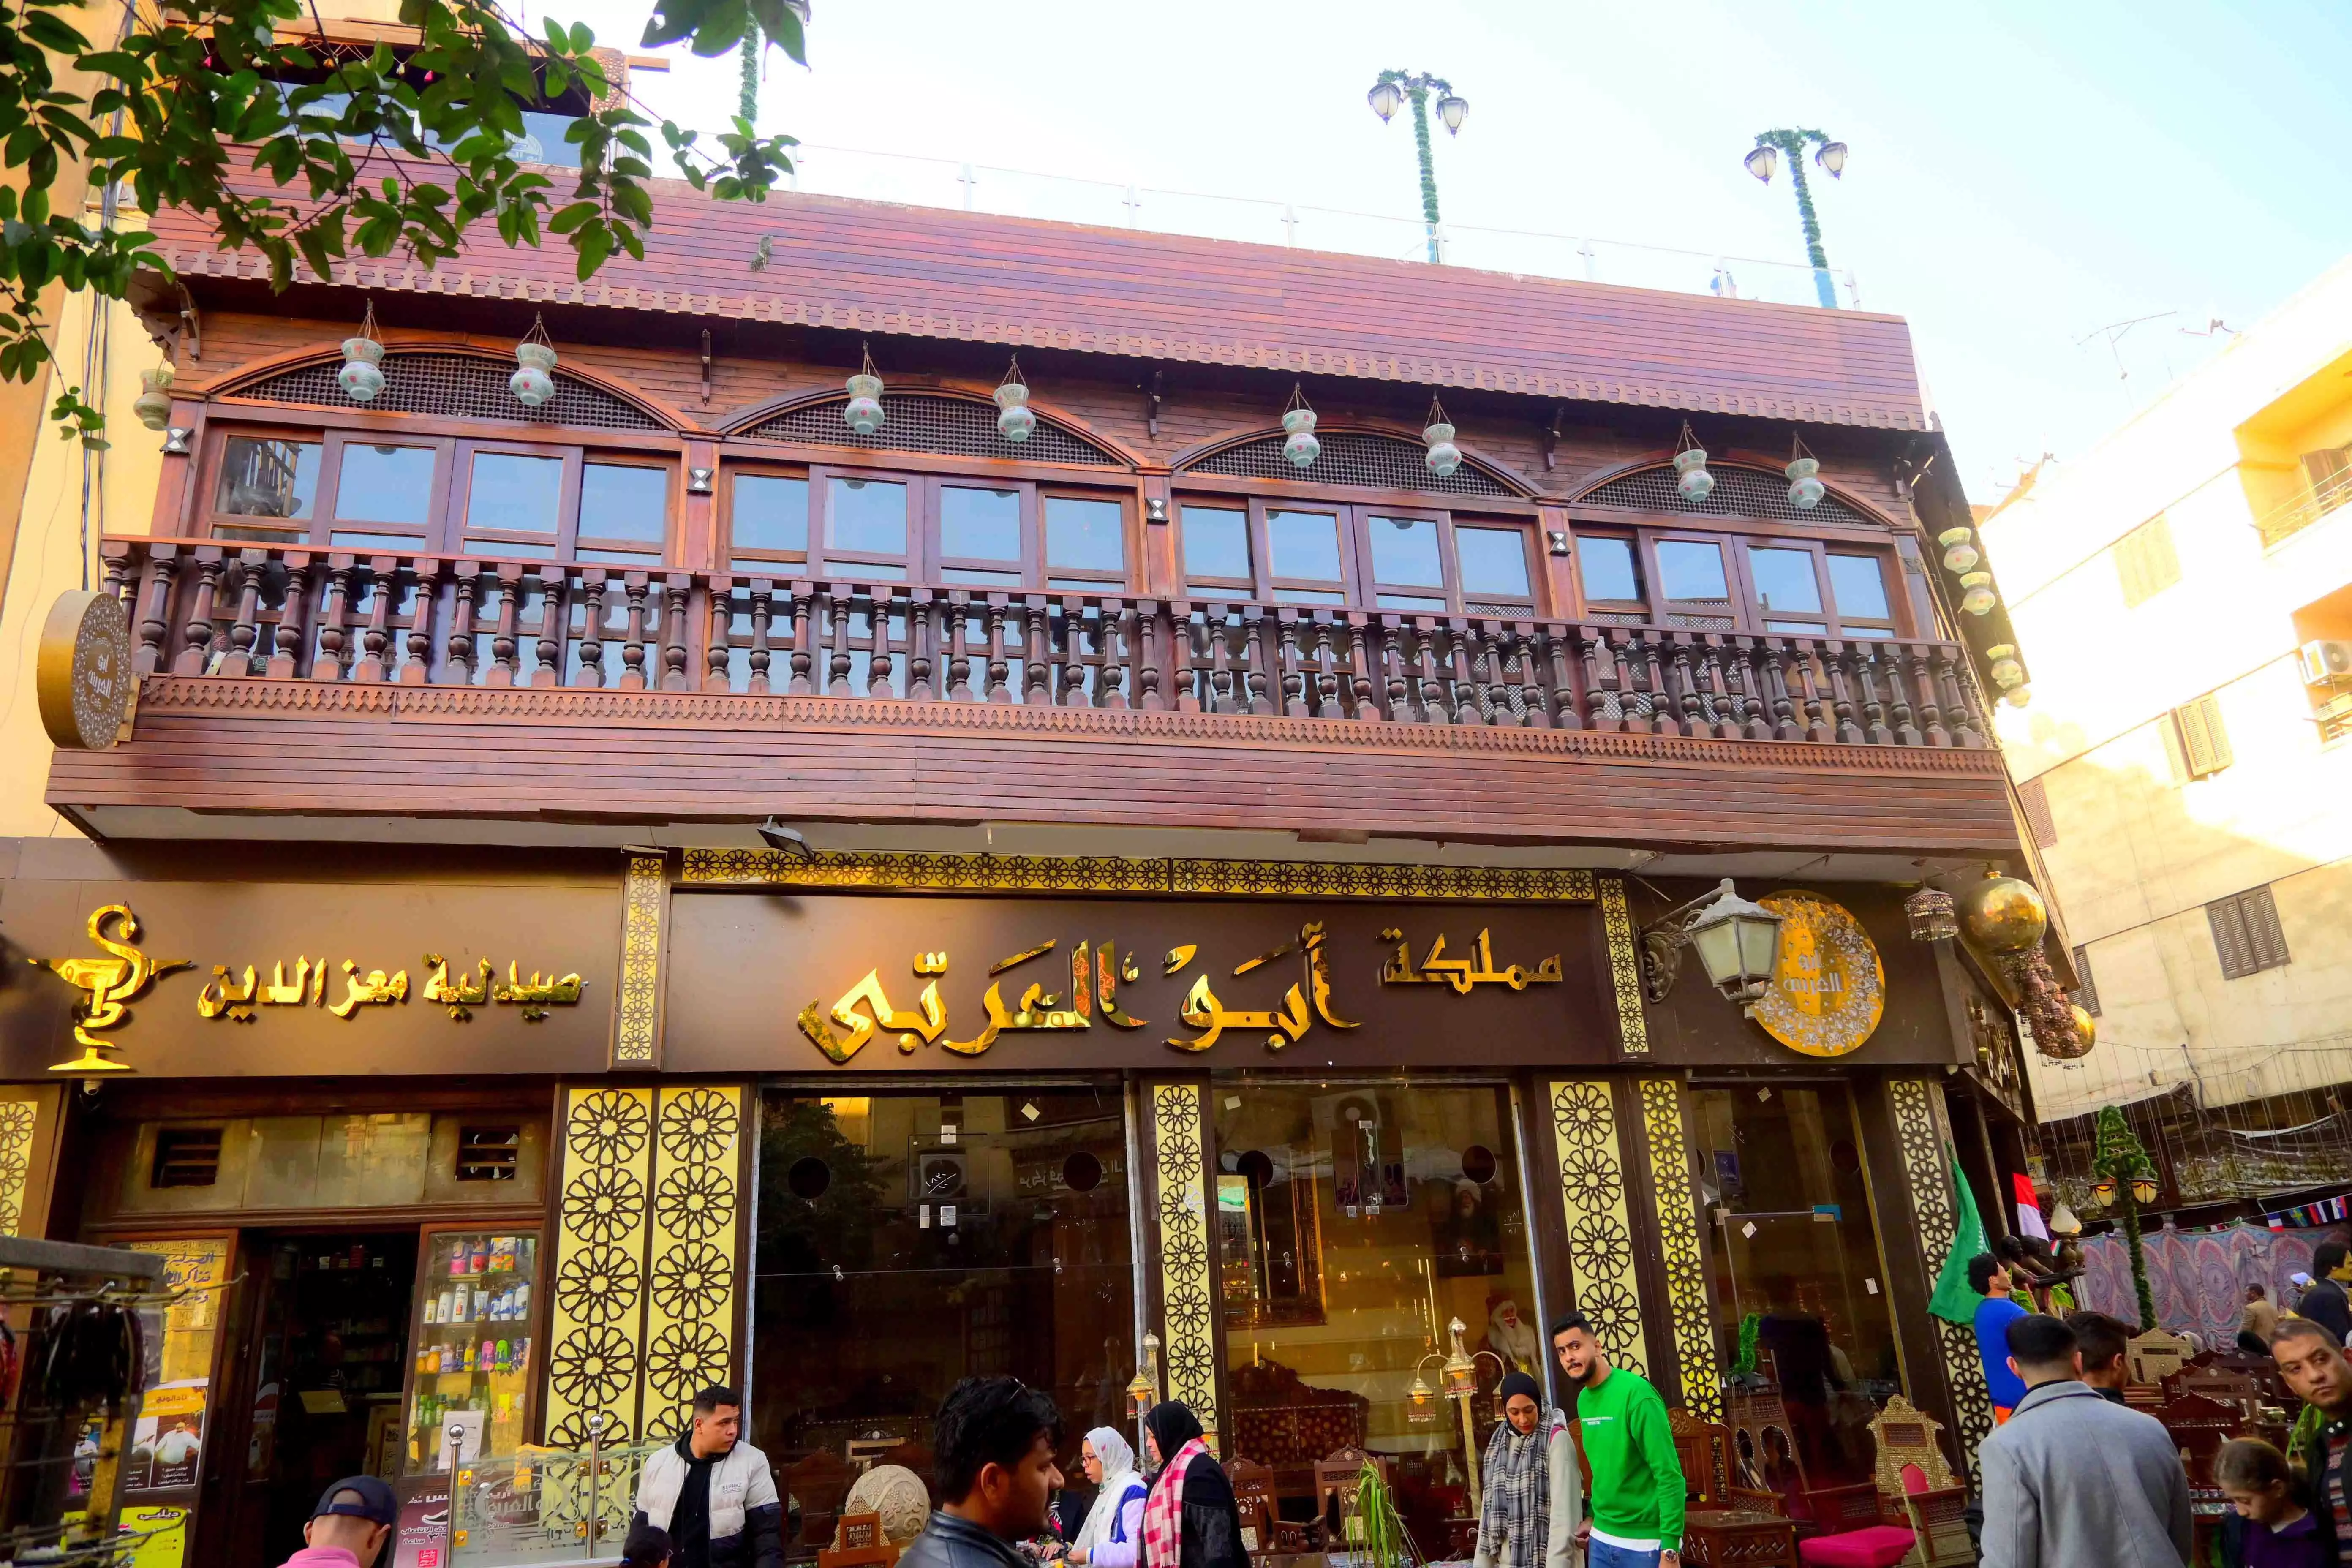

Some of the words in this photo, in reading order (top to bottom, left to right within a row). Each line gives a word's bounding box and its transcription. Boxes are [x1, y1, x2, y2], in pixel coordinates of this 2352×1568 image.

[198, 954, 327, 1023] الدين
[329, 958, 409, 1018] معز
[422, 953, 585, 1021] صيدلية
[1384, 926, 1564, 994] مملكة
